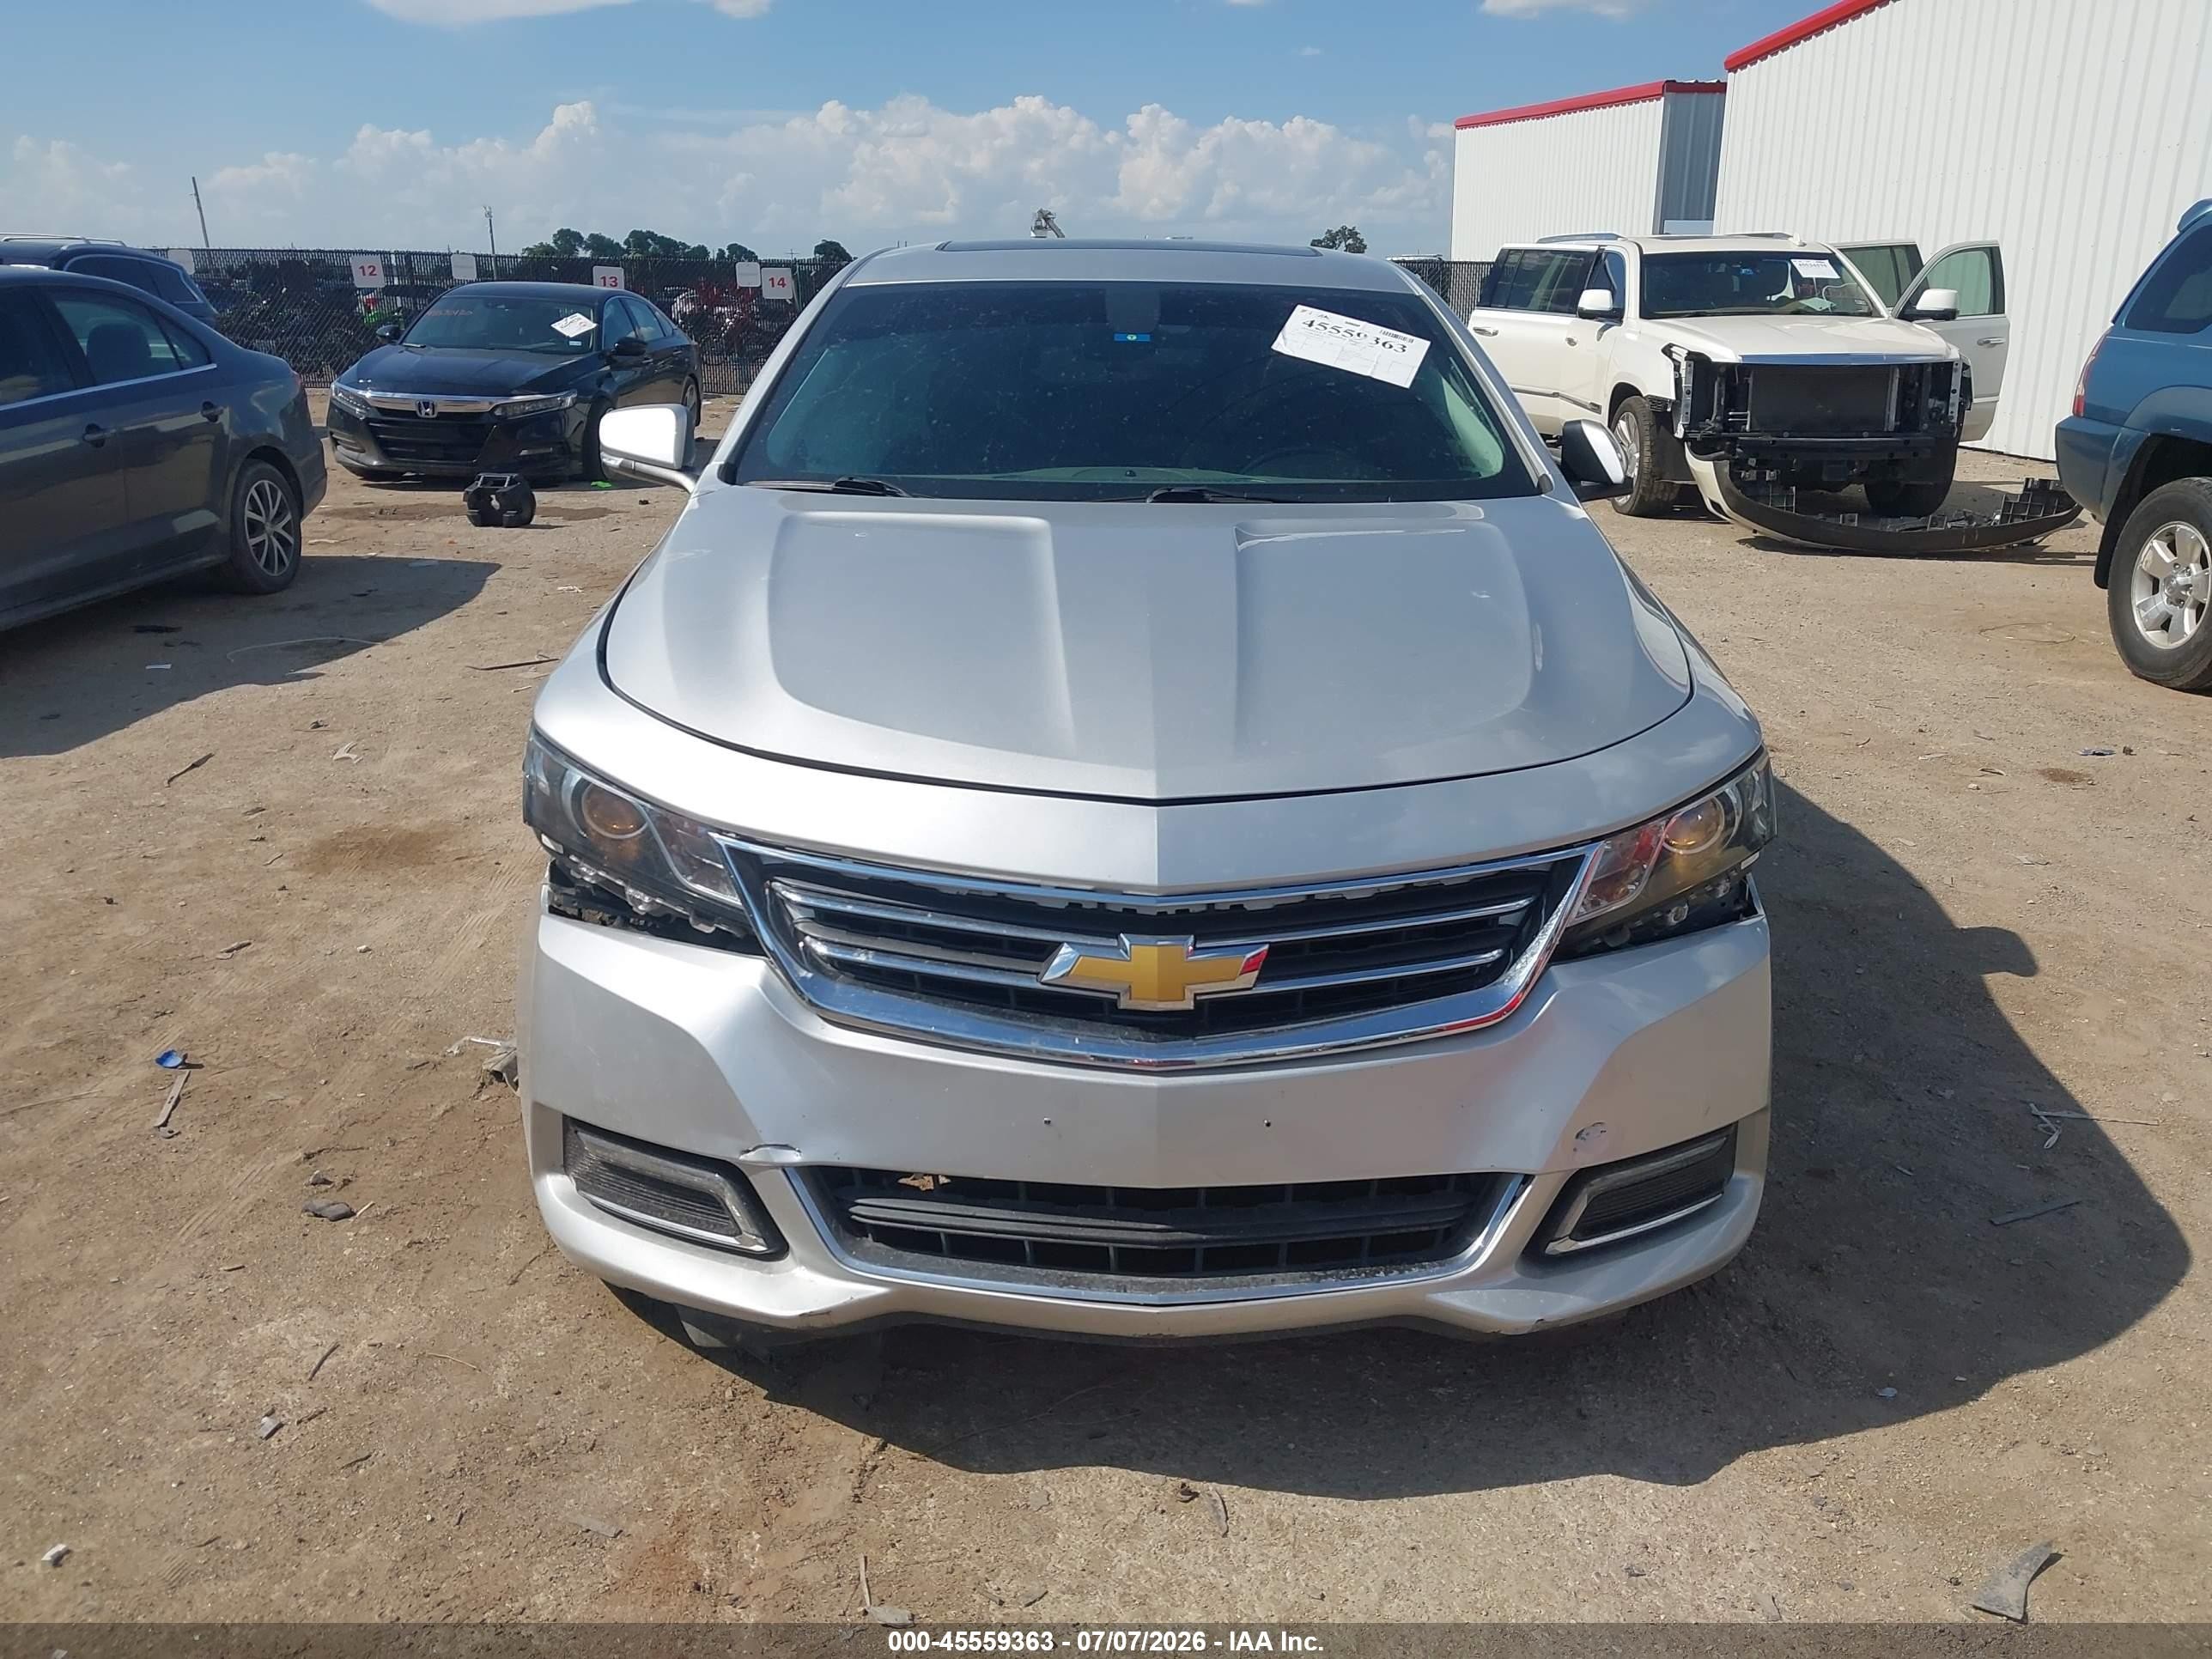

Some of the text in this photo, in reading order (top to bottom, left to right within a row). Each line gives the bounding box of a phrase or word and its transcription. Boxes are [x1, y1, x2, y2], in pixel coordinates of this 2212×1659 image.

[358, 264, 378, 276] 12
[599, 275, 619, 288] 13
[769, 276, 787, 289] 14
